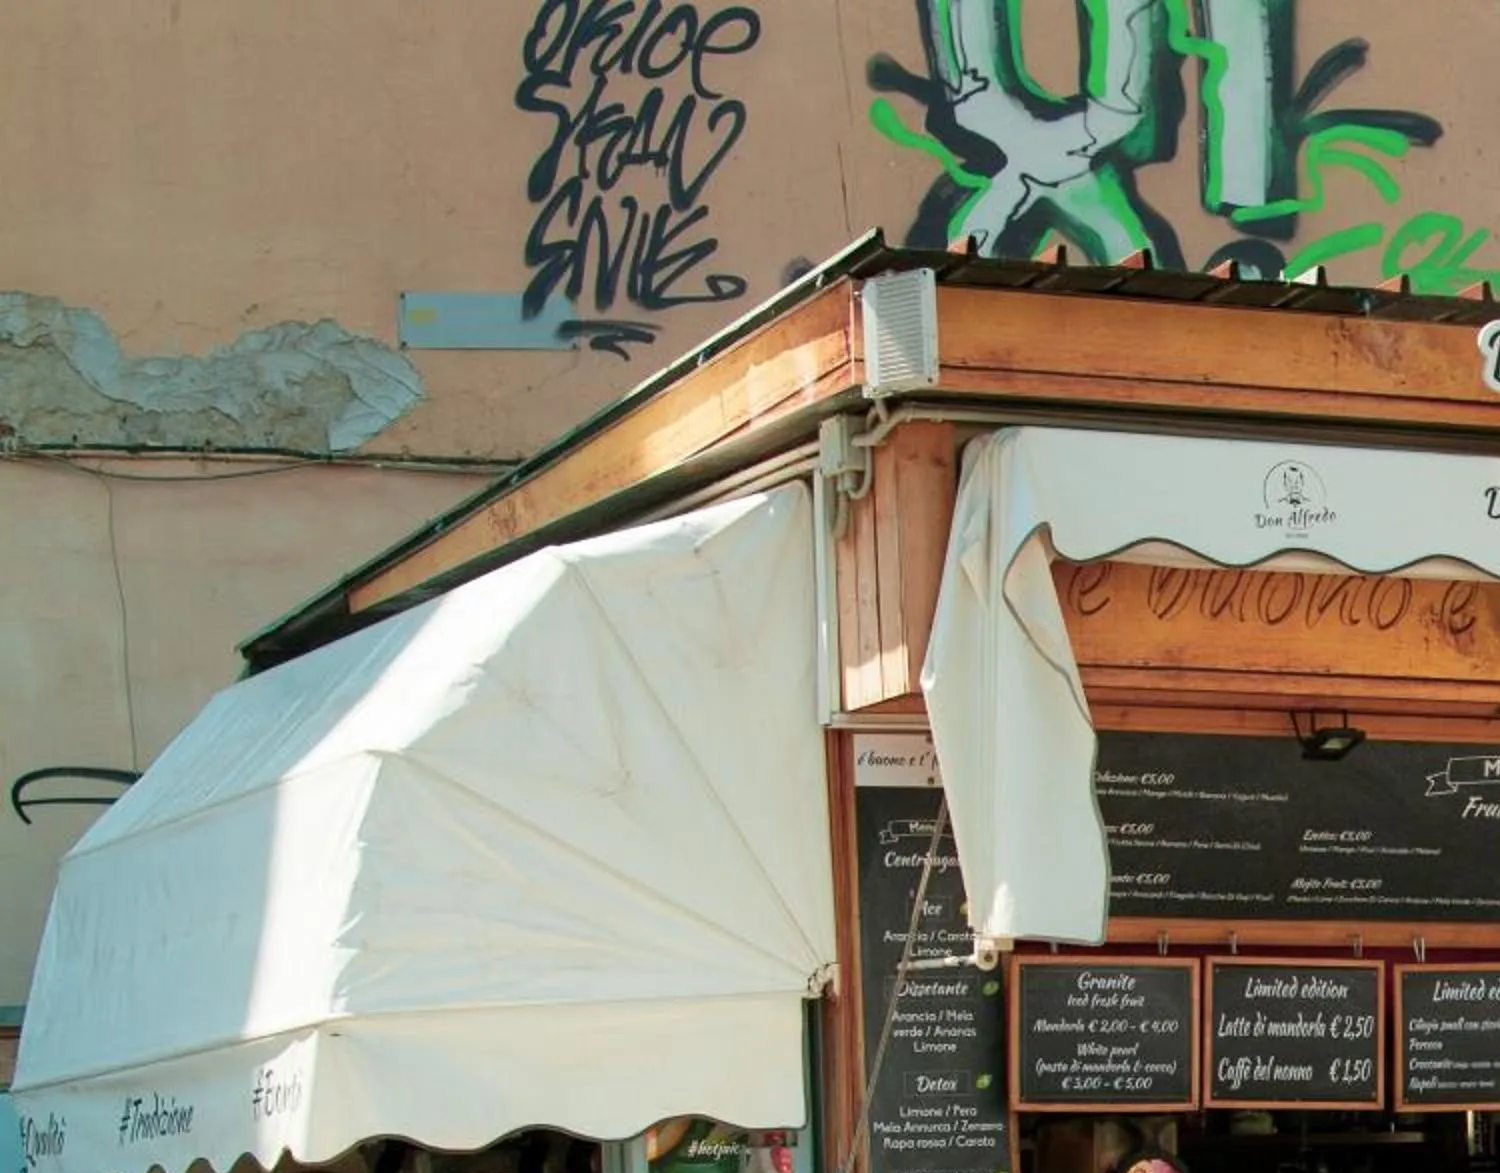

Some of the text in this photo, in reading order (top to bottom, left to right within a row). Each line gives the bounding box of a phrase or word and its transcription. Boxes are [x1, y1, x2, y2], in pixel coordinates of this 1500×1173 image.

[1254, 506, 1336, 529] Don Alfredo
[1076, 971, 1137, 992] Granite
[1244, 975, 1349, 1000] Limited edition
[1432, 979, 1485, 1002] Limited
[1217, 1013, 1251, 1038] Latte
[1253, 1011, 1267, 1037] di
[1267, 1011, 1328, 1037] mandorla
[913, 1041, 957, 1053] Limone
[1253, 1055, 1275, 1081] del
[1273, 1063, 1313, 1081] nonno
[916, 1075, 958, 1093] Detox
